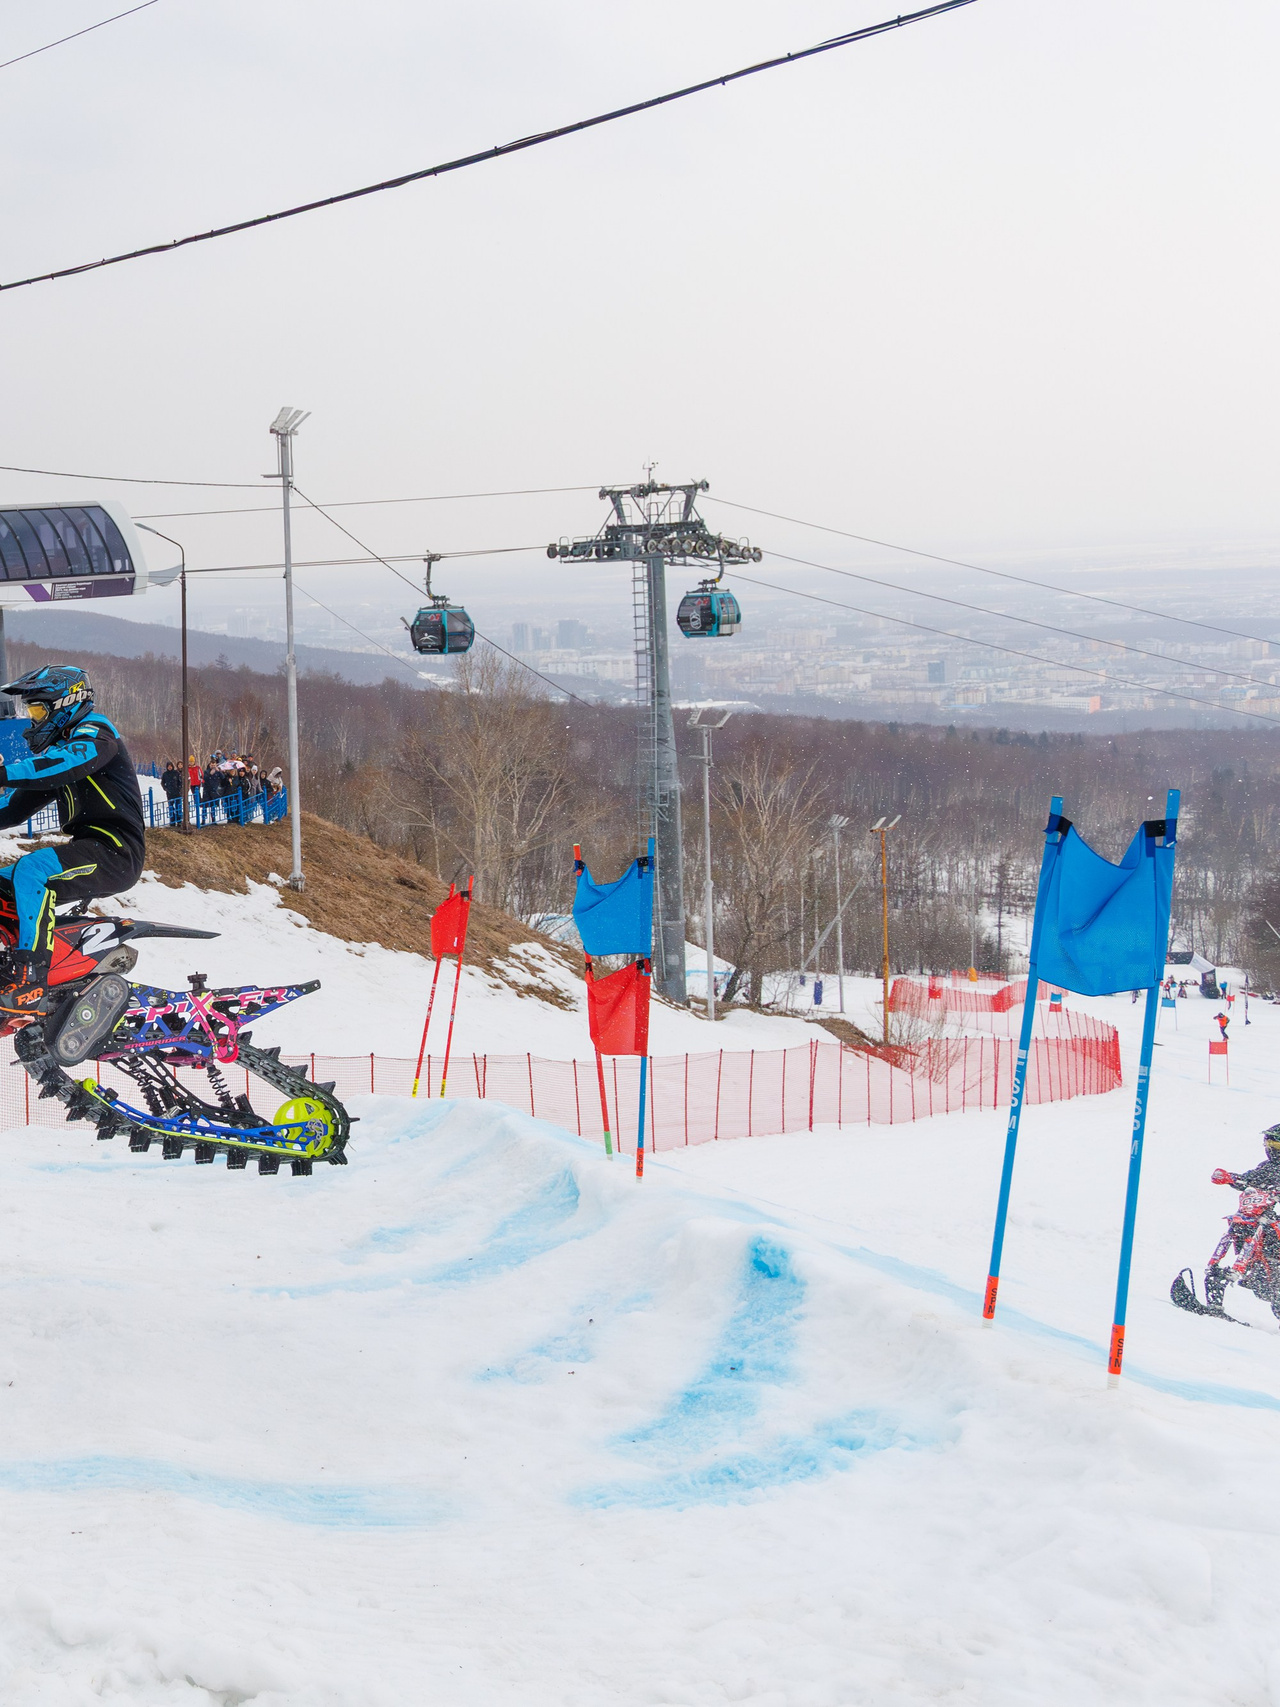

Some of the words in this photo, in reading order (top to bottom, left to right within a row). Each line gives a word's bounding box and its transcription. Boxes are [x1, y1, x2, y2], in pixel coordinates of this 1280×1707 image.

[53, 689, 95, 710] 100%
[81, 922, 120, 956] 2
[15, 987, 44, 1006] FXR
[123, 1035, 187, 1050] SNOWRIDER
